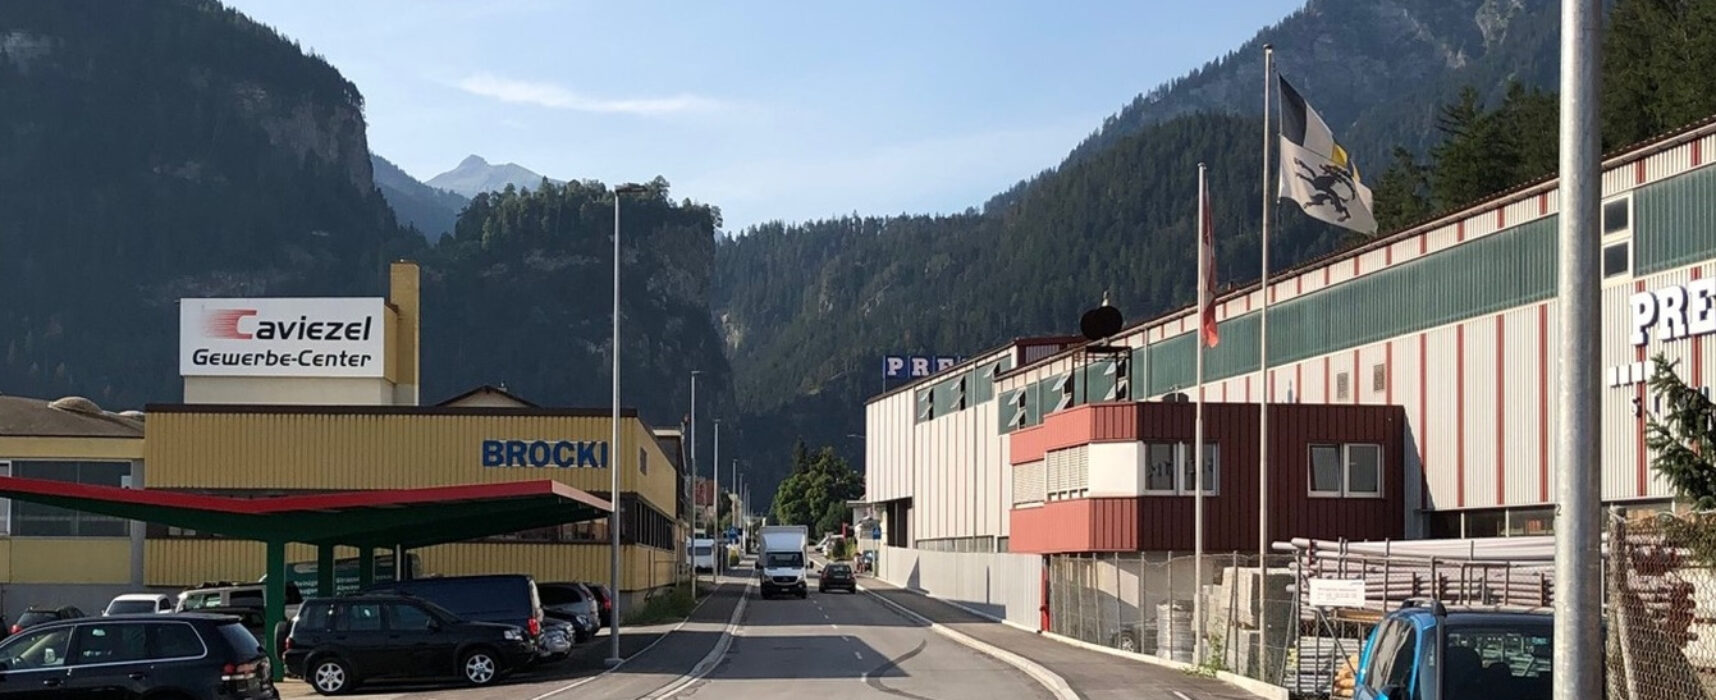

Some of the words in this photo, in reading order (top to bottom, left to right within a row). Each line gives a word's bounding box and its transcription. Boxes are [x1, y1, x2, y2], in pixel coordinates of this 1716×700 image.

[205, 309, 372, 340] Caviezel
[193, 349, 371, 366] Gewerbe-Center
[483, 440, 608, 467] BROCKI
